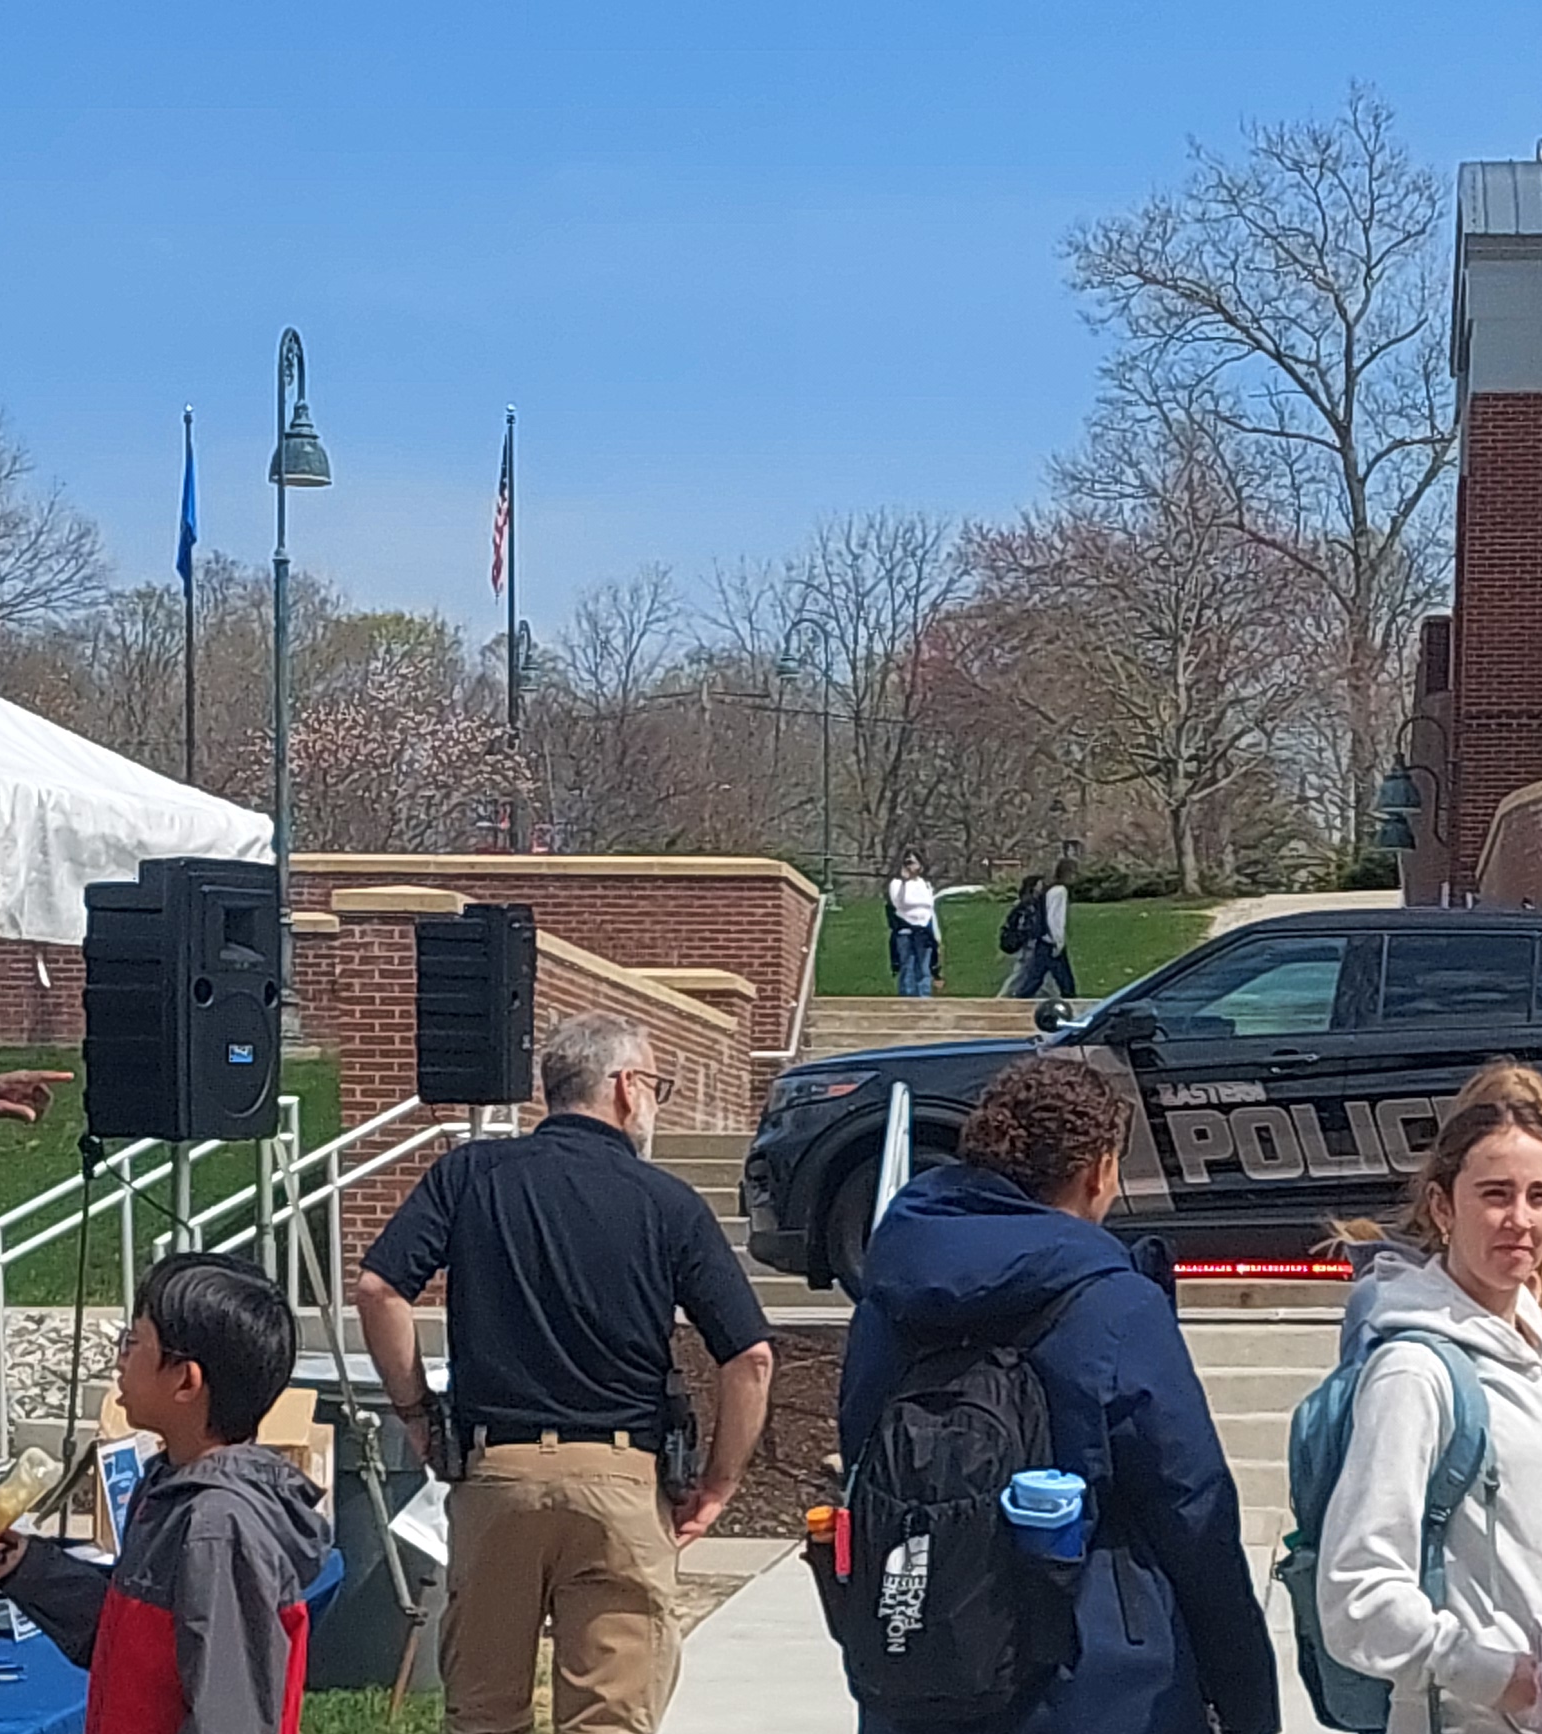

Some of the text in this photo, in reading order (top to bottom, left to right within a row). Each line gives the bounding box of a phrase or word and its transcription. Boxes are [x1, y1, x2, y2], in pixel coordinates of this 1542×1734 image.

[1156, 1080, 1266, 1106] EASTERN
[1164, 1096, 1458, 1183] POLIC
[877, 1575, 900, 1618] THE
[905, 1576, 928, 1629] FACE
